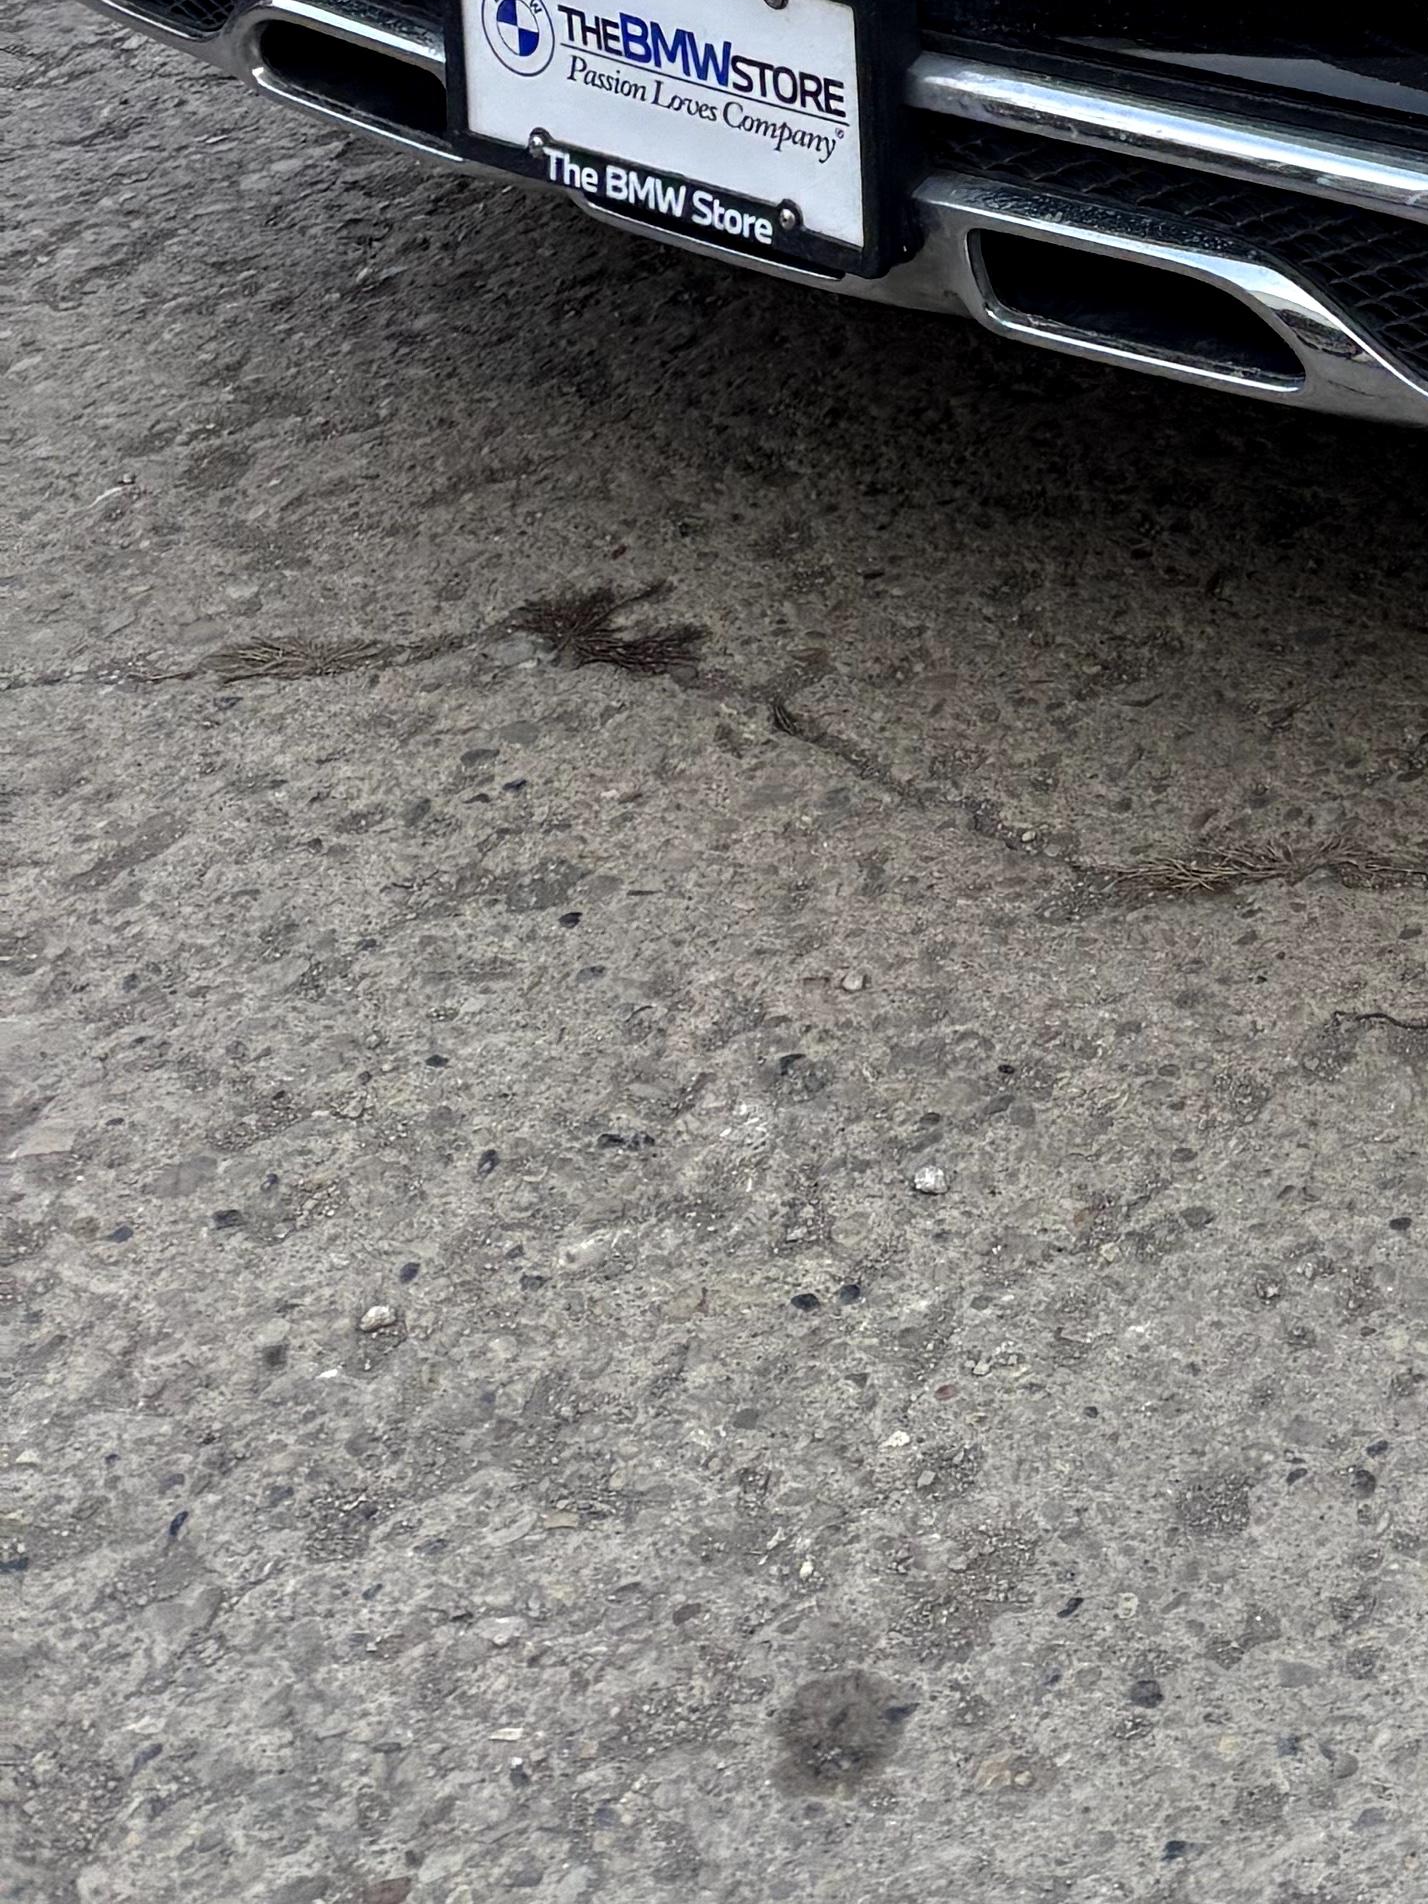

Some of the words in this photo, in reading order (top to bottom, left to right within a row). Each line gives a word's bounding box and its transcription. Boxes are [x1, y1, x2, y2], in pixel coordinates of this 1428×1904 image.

[566, 54, 647, 102] Passion
[650, 79, 718, 122] Loves
[543, 146, 598, 193] The
[606, 164, 686, 218] BMW
[692, 189, 773, 245] Store
